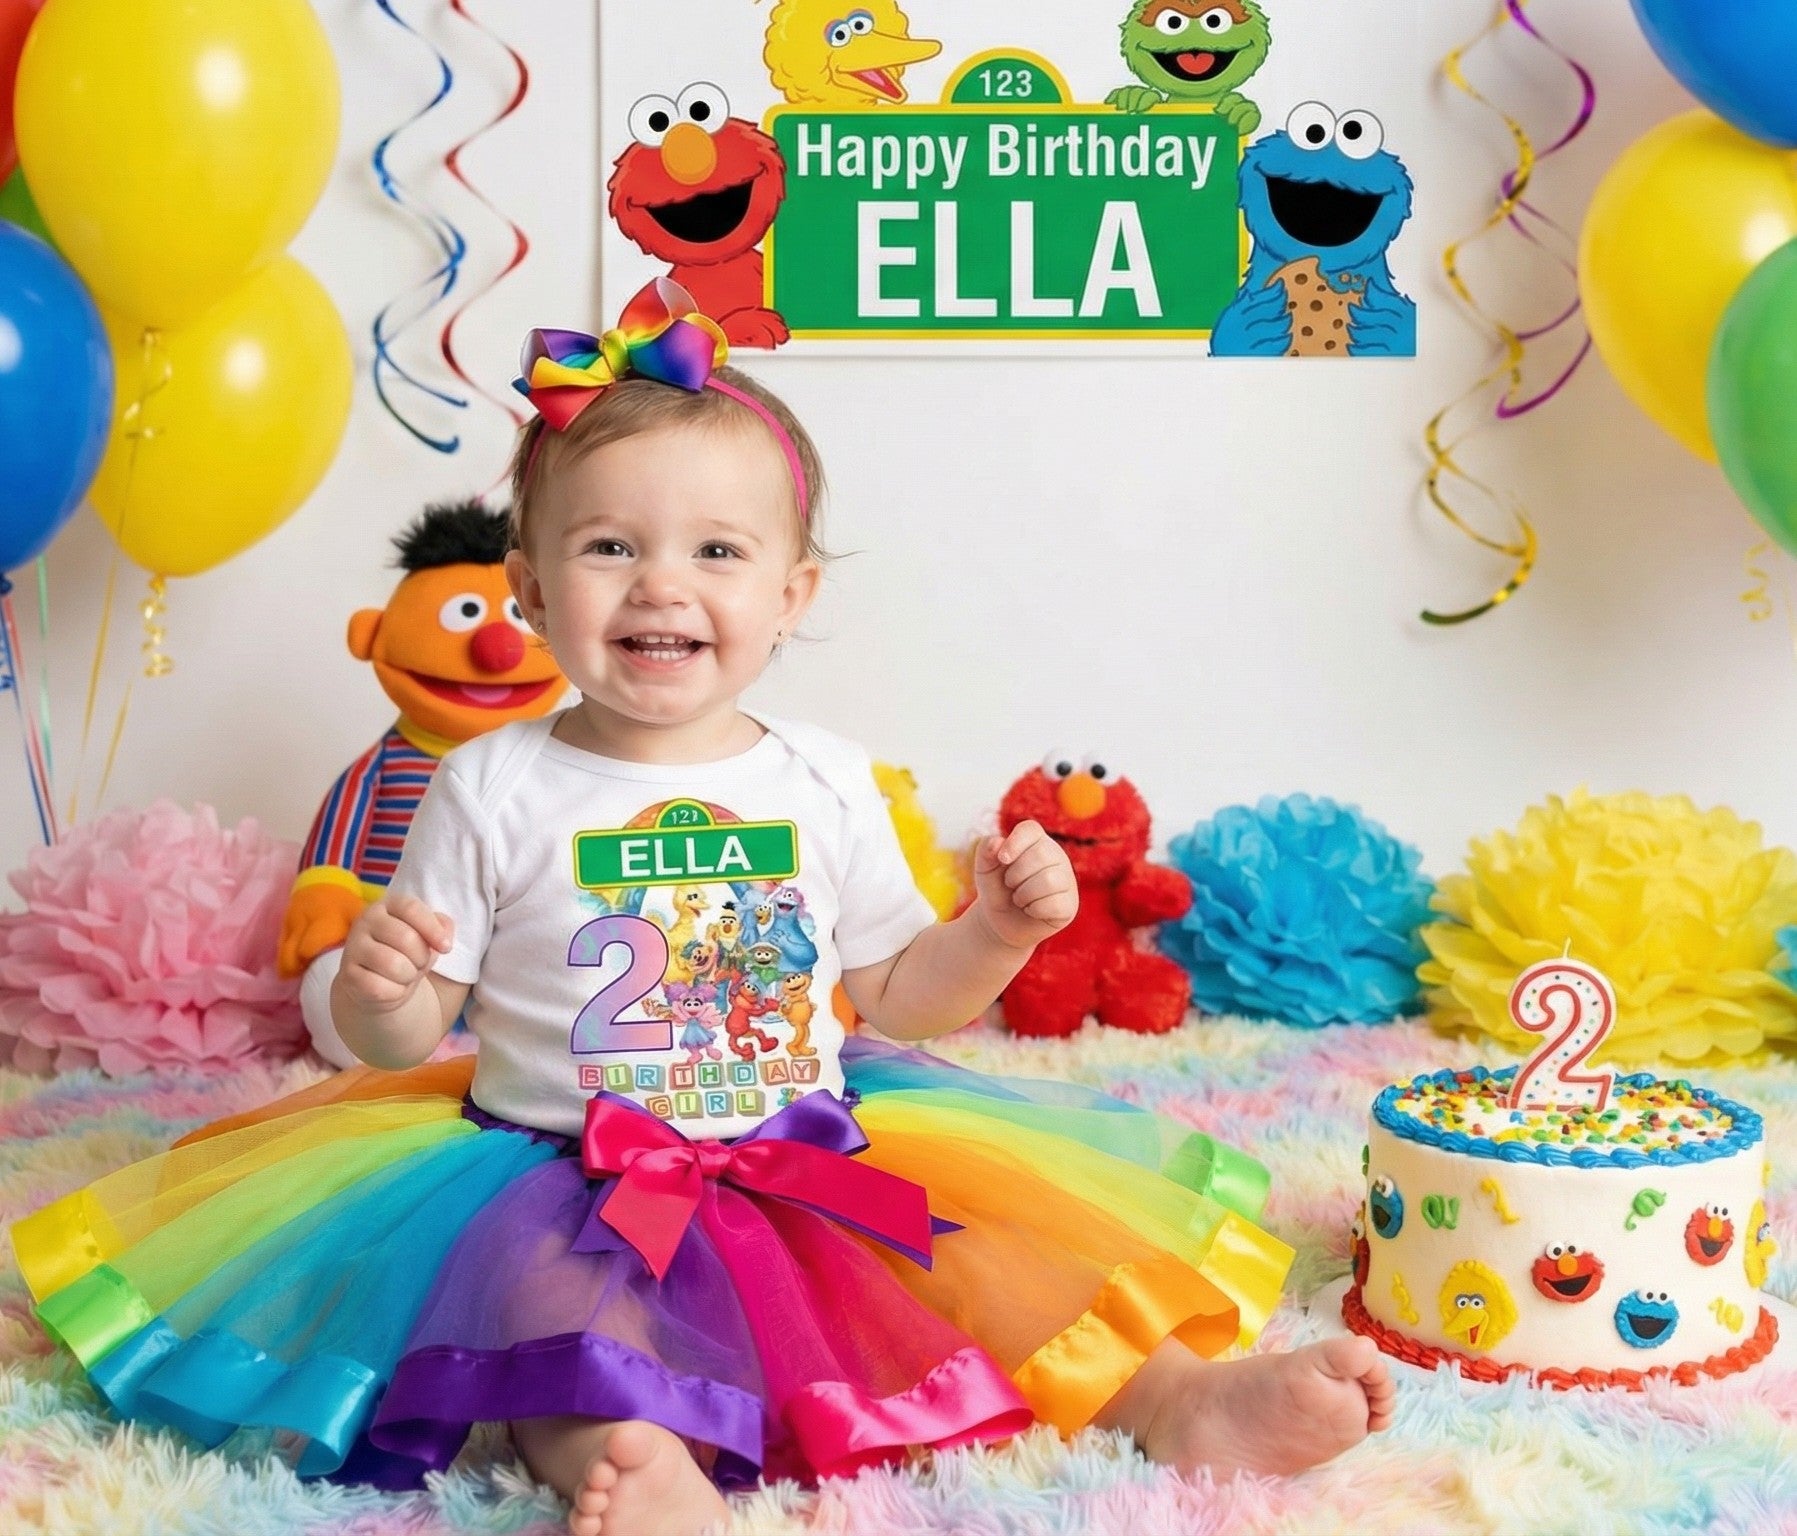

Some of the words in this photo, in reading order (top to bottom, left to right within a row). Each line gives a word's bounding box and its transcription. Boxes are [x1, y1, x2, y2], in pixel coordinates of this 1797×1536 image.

[978, 69, 1033, 97] 123
[798, 124, 967, 189] Happy
[989, 124, 1216, 189] Birthday
[858, 201, 1162, 317] ELLA
[619, 835, 753, 878] ELLA
[567, 914, 673, 1054] 2
[1508, 956, 1615, 1112] 2
[580, 1060, 812, 1088] BIRTHDAY
[648, 1092, 759, 1117] GIRL
